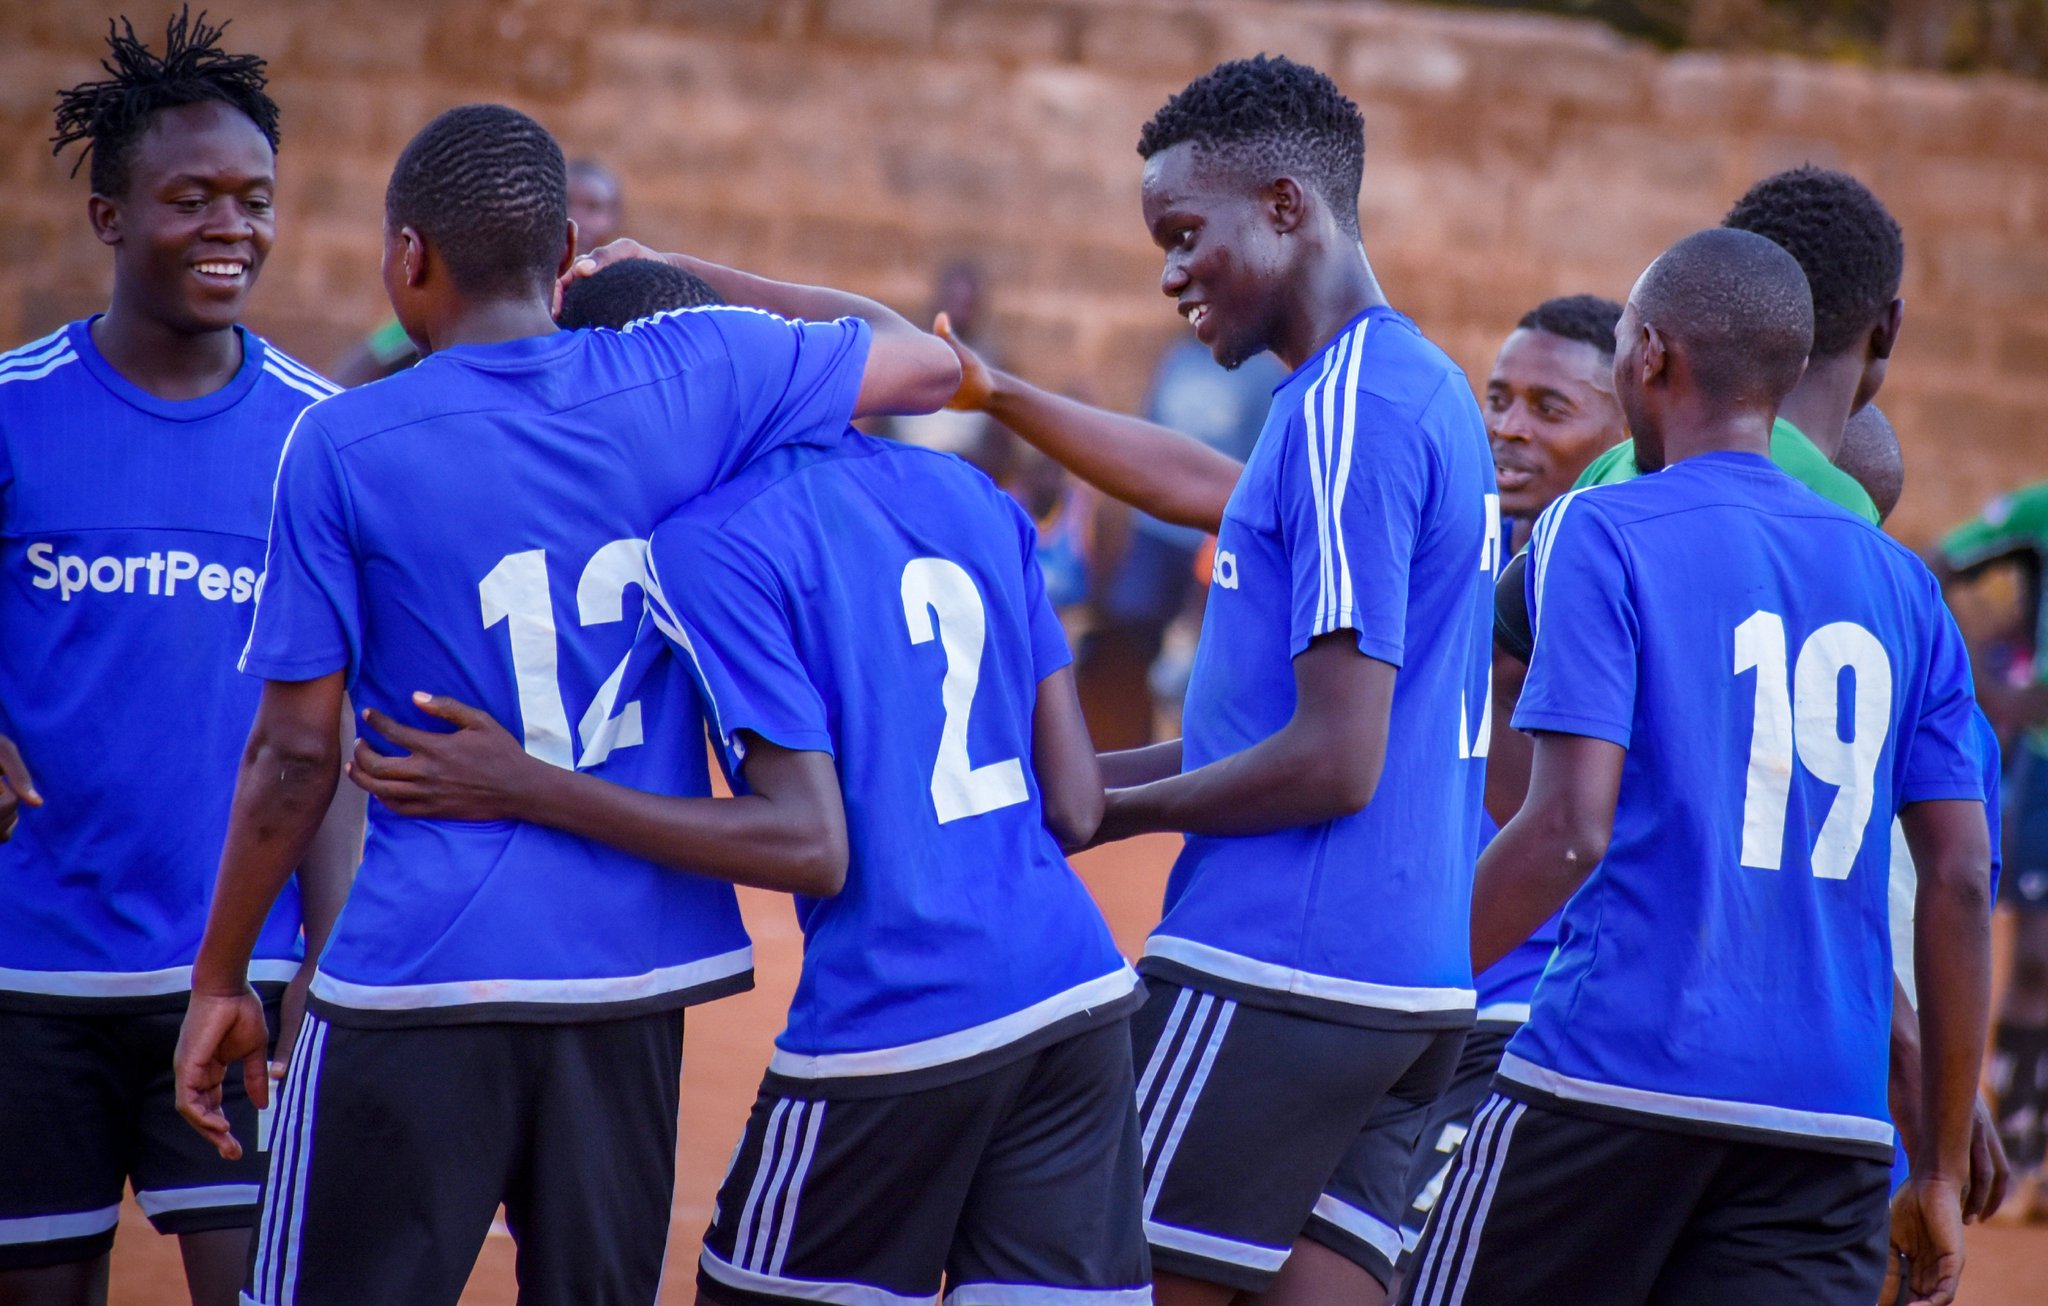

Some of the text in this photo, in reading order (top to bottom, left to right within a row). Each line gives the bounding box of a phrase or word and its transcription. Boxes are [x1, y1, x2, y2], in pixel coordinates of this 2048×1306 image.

[479, 538, 649, 772] 12
[901, 557, 1030, 825] 2
[1734, 609, 1892, 880] 19
